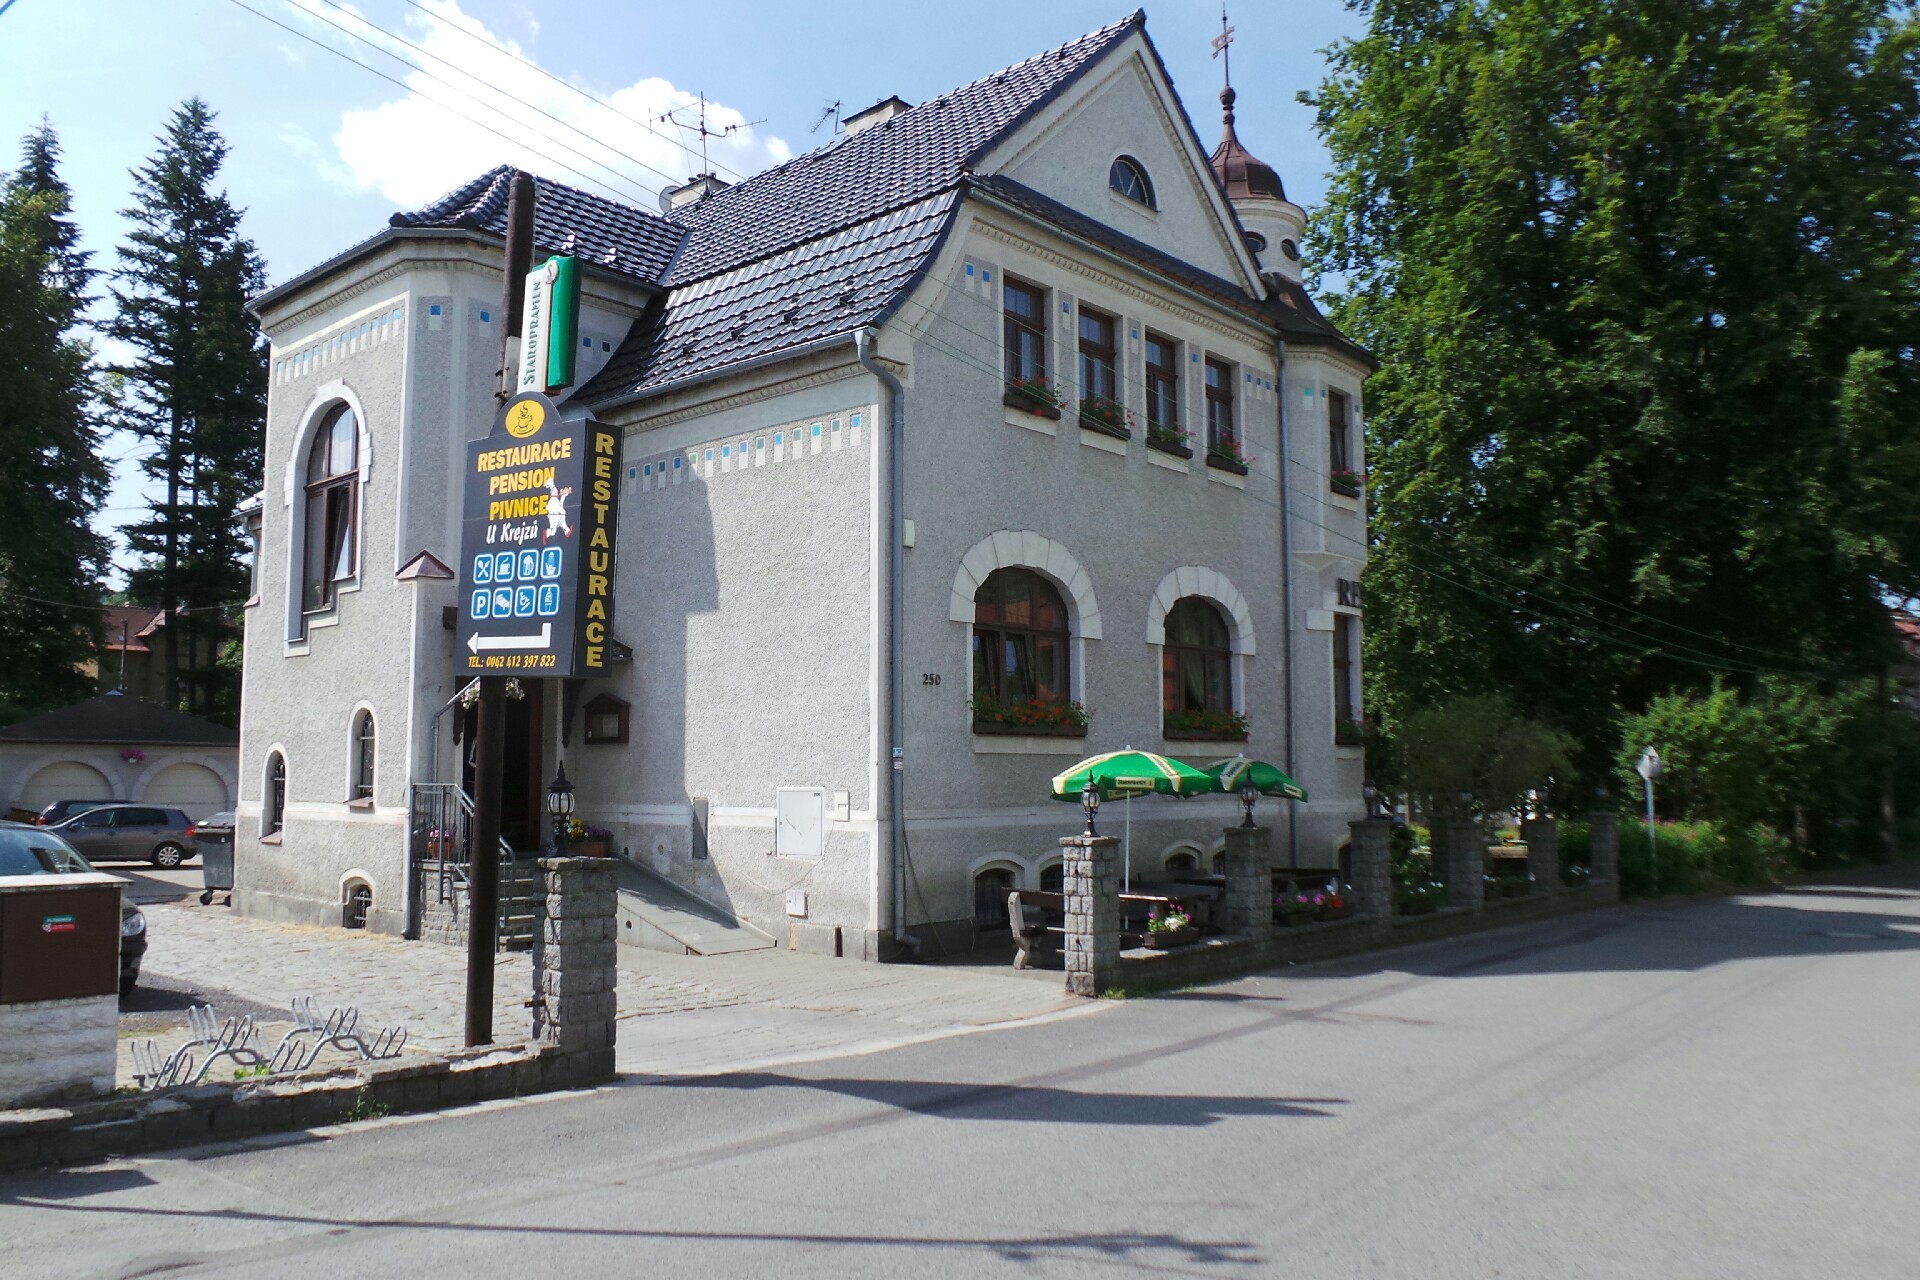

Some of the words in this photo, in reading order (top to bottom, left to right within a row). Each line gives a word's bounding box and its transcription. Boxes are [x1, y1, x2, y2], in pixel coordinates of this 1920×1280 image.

[477, 437, 572, 472] RESTAURACE
[489, 466, 555, 495] PENSION
[489, 494, 549, 521] PIVNICE
[486, 524, 497, 544] U
[500, 519, 539, 546] Krejzů
[586, 432, 615, 668] RESTAURACE
[506, 655, 520, 668] 412
[523, 655, 539, 668] 397
[540, 654, 556, 667] 822
[922, 673, 941, 686] 250
